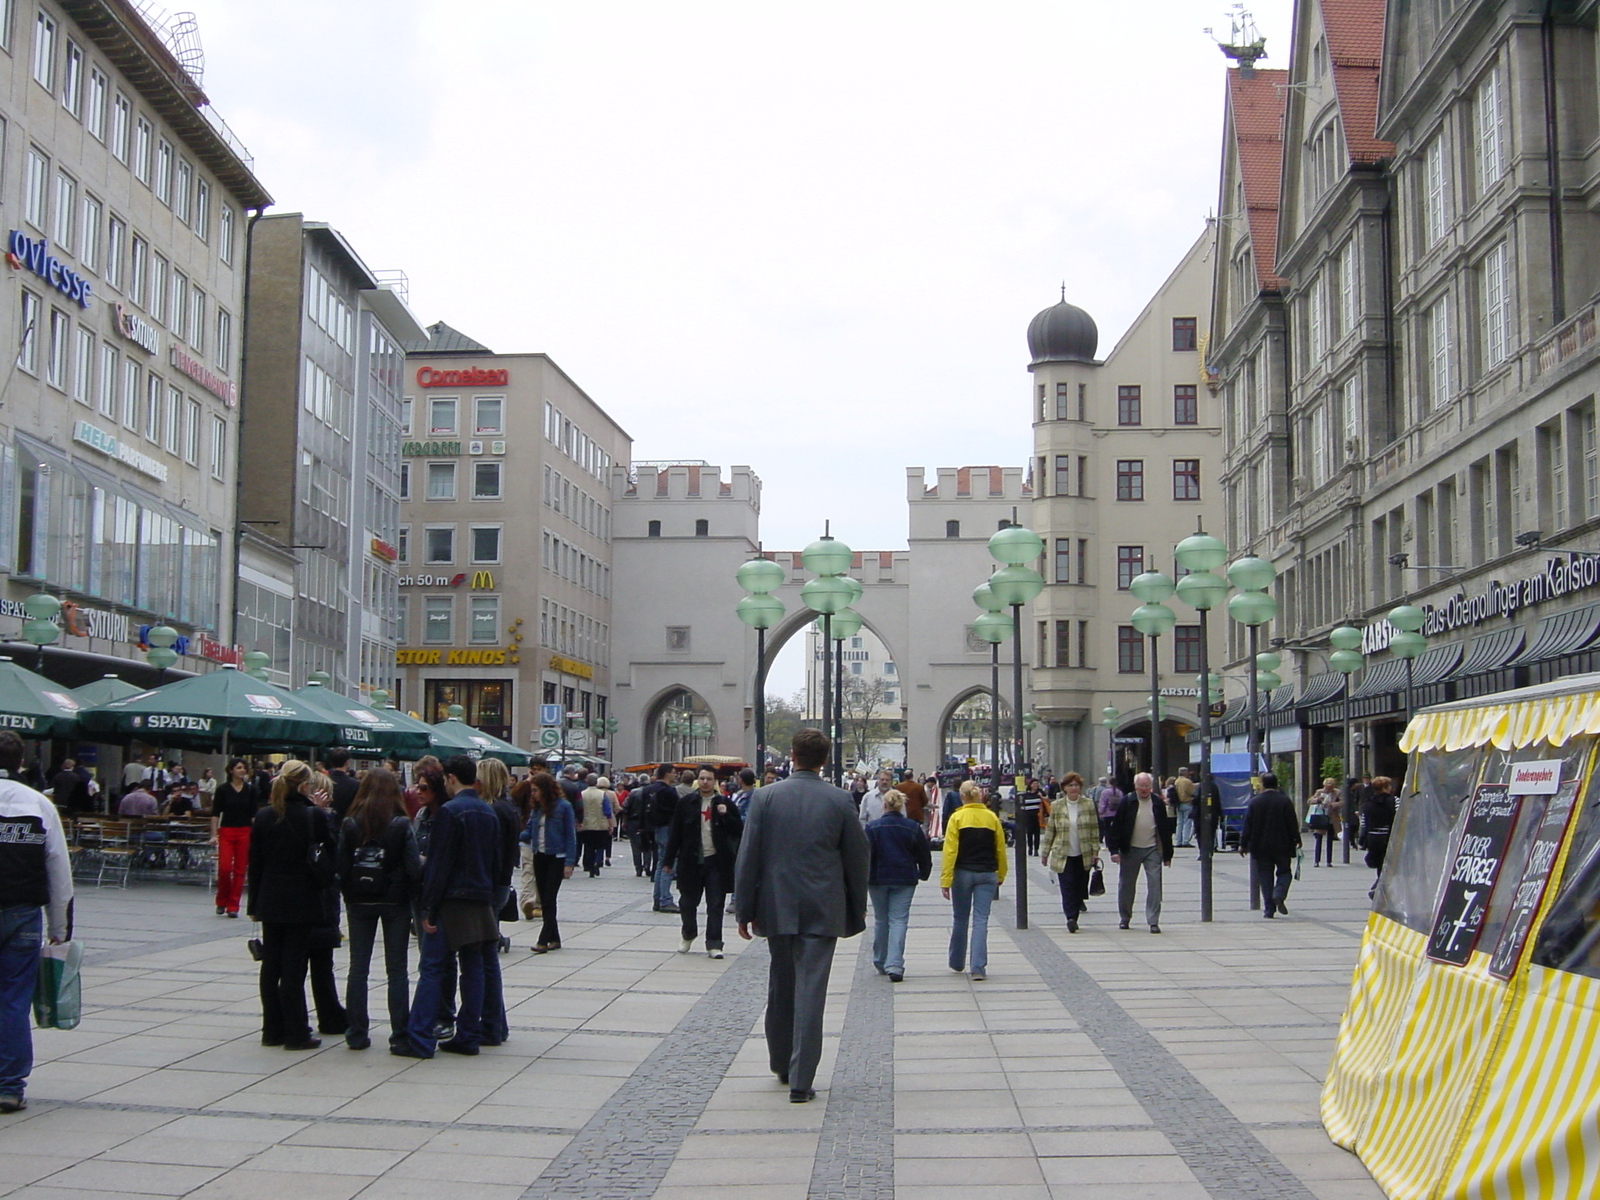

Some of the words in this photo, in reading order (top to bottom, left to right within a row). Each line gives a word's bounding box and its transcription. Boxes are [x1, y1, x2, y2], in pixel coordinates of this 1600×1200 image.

[12, 230, 92, 309] oviesse
[131, 314, 160, 356] SATURN
[416, 366, 509, 388] Cornelsen
[80, 421, 115, 456] HELA
[416, 574, 433, 586] 50
[436, 576, 449, 586] m
[1523, 573, 1543, 605] am
[88, 608, 129, 643] SATURN
[395, 650, 442, 665] STOR
[446, 650, 507, 665] KINOS
[0, 713, 37, 730] TEN
[147, 715, 212, 731] SPATEN
[543, 706, 558, 723] U
[543, 730, 559, 747] S
[1459, 834, 1492, 858] DICKER
[1451, 856, 1498, 886] SPARGEL
